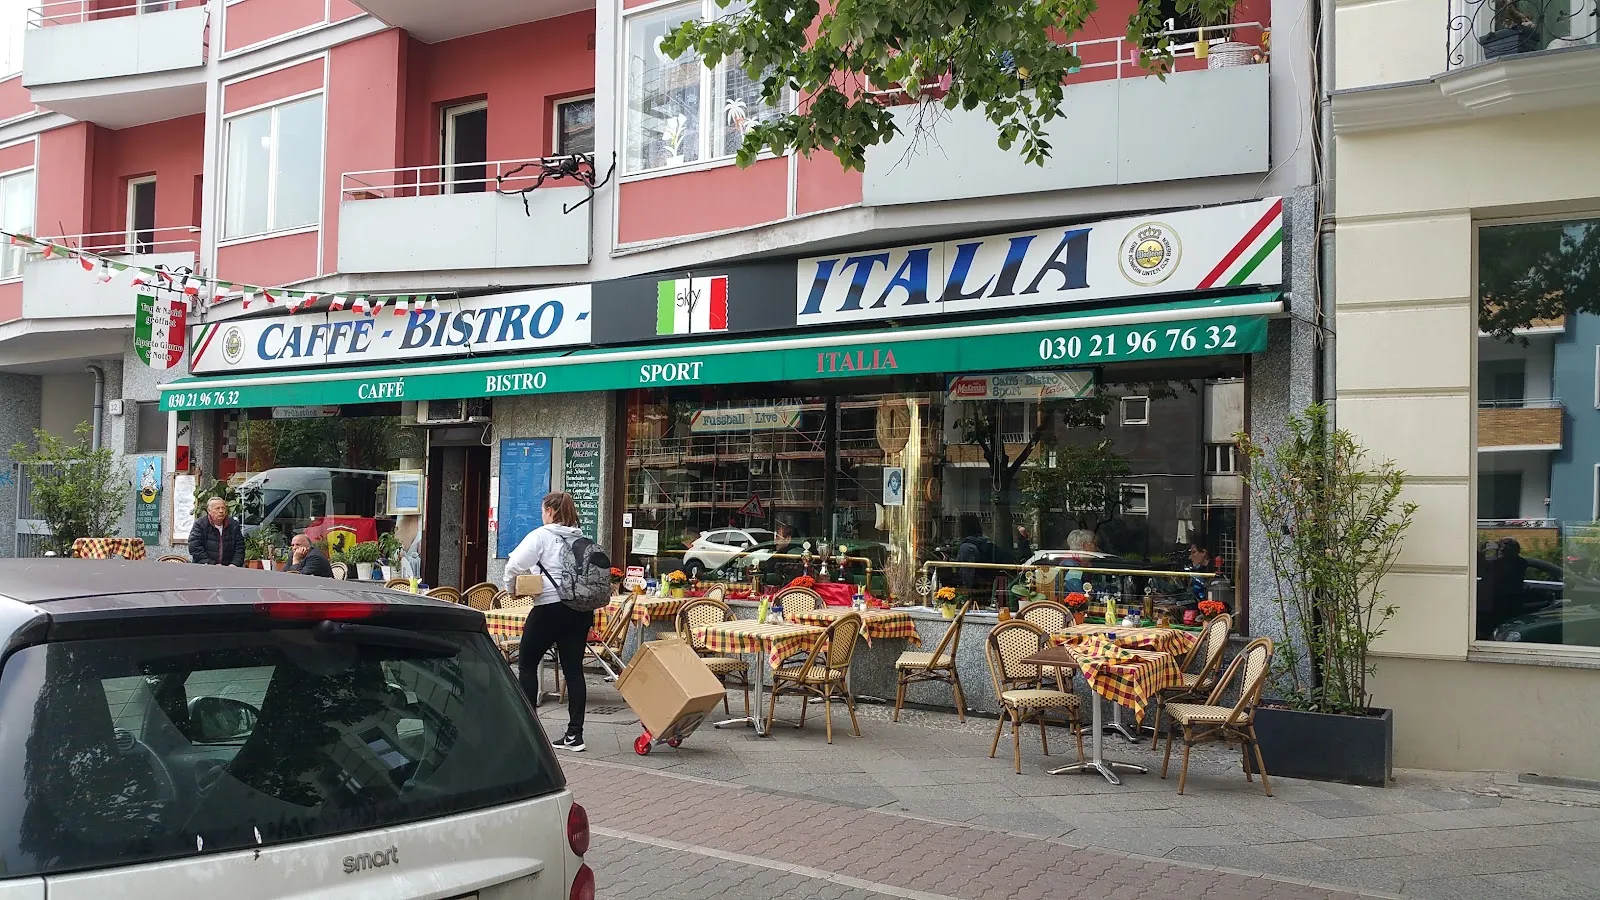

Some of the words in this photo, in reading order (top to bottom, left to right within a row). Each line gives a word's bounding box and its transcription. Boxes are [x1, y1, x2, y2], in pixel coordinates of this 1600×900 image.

[798, 227, 1093, 316] ITALIA
[141, 303, 154, 314] Tag
[163, 307, 182, 317] Nacht
[676, 288, 700, 313] sky
[145, 316, 176, 327] geöffnet
[398, 300, 564, 350] BISTRO
[136, 338, 158, 348] Aperto
[1039, 335, 1082, 360] 030
[1088, 333, 1116, 357] 21
[1125, 330, 1157, 355] 96
[1165, 326, 1197, 352] 76
[1204, 324, 1237, 349] 32
[153, 352, 172, 361] Notte
[816, 349, 898, 373] ITALIA
[485, 372, 546, 392] BISTRO
[639, 361, 703, 383] SPORT
[1025, 374, 1058, 384] Bistro
[358, 377, 405, 399] CAFFÉ
[992, 387, 1021, 397] Sport
[168, 394, 185, 408] 030
[186, 393, 197, 406] 21
[199, 392, 212, 406] 96
[214, 391, 225, 405] 76
[226, 390, 239, 405] 32
[702, 413, 745, 426] Fussball
[755, 412, 778, 423] Live
[343, 845, 399, 874] smart
